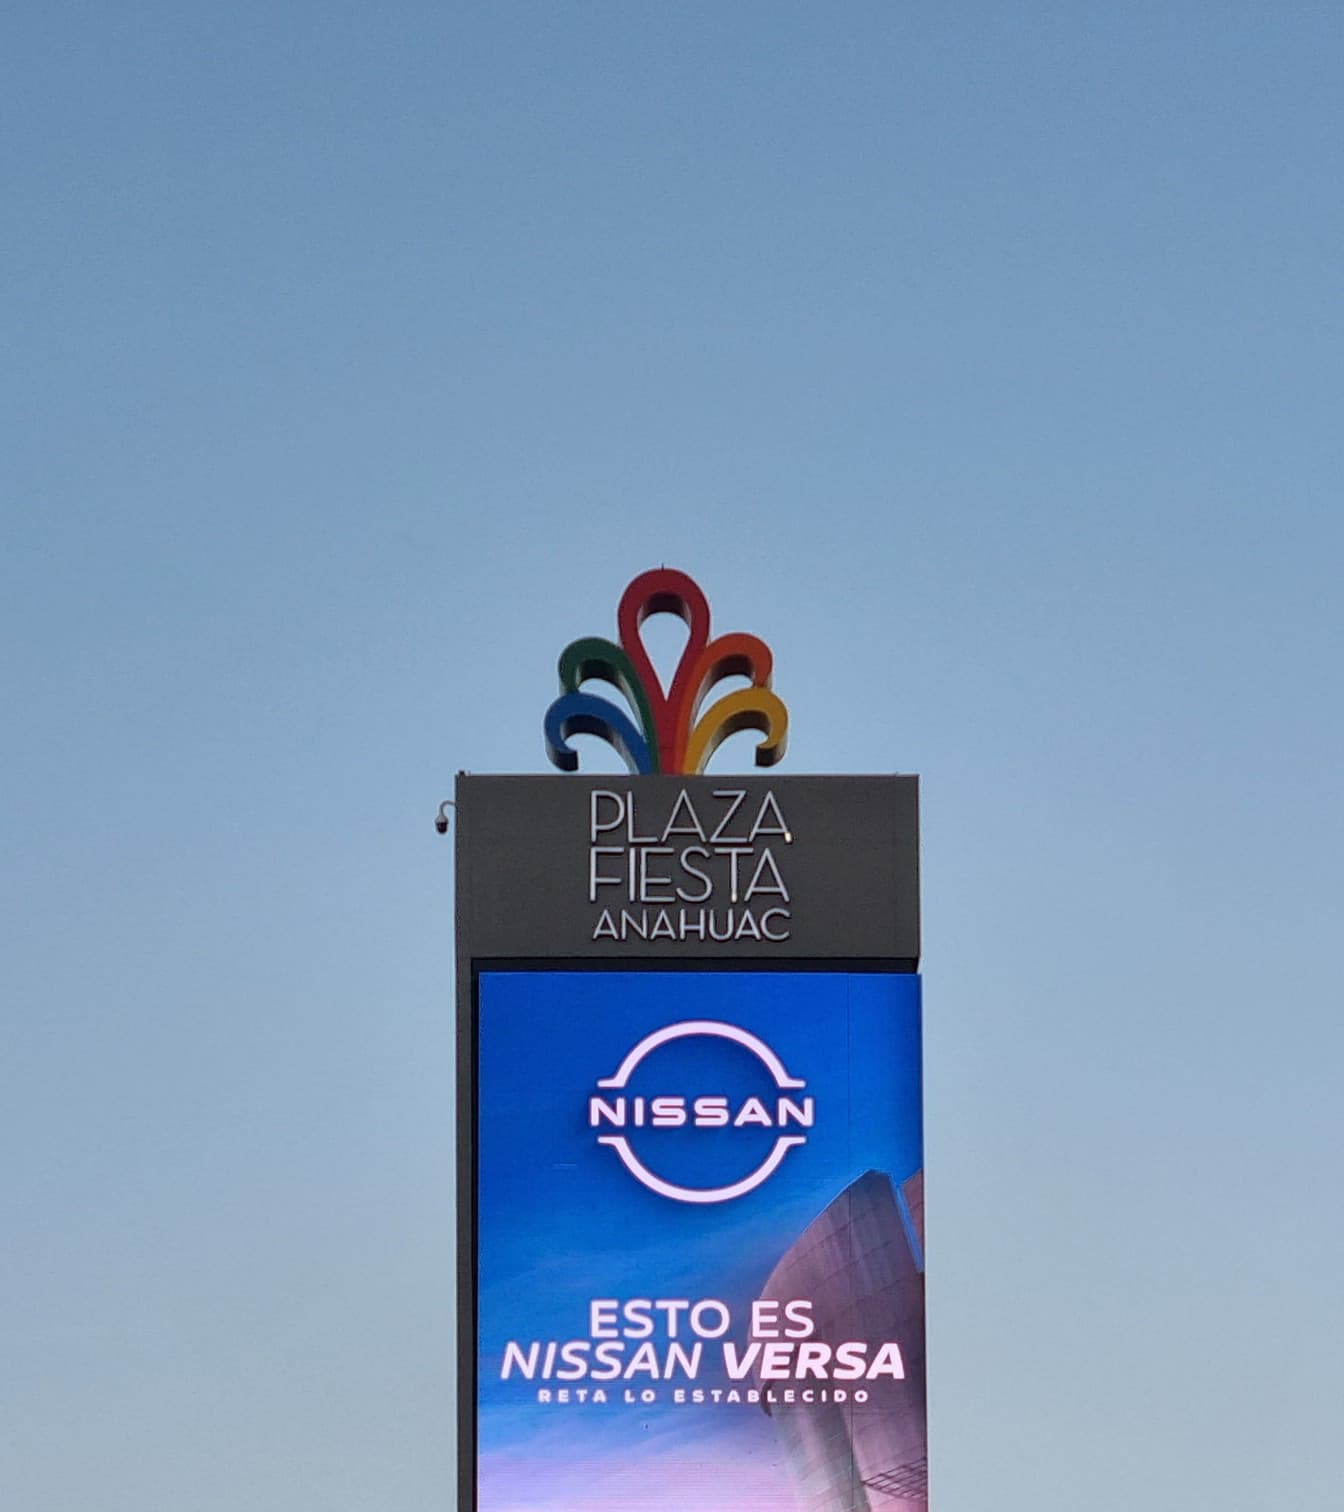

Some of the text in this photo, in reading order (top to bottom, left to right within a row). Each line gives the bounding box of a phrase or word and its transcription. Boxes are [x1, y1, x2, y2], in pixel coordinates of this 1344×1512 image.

[589, 789, 791, 843] PLAZA
[588, 846, 790, 903] FIESTA
[591, 908, 792, 941] ANAHUAC
[589, 1097, 814, 1127] NISSAN
[590, 1299, 814, 1339] ESTO ES
[500, 1342, 906, 1380] NISSAN VERSA
[538, 1388, 870, 1404] RETA LO ESTABLECIDO
